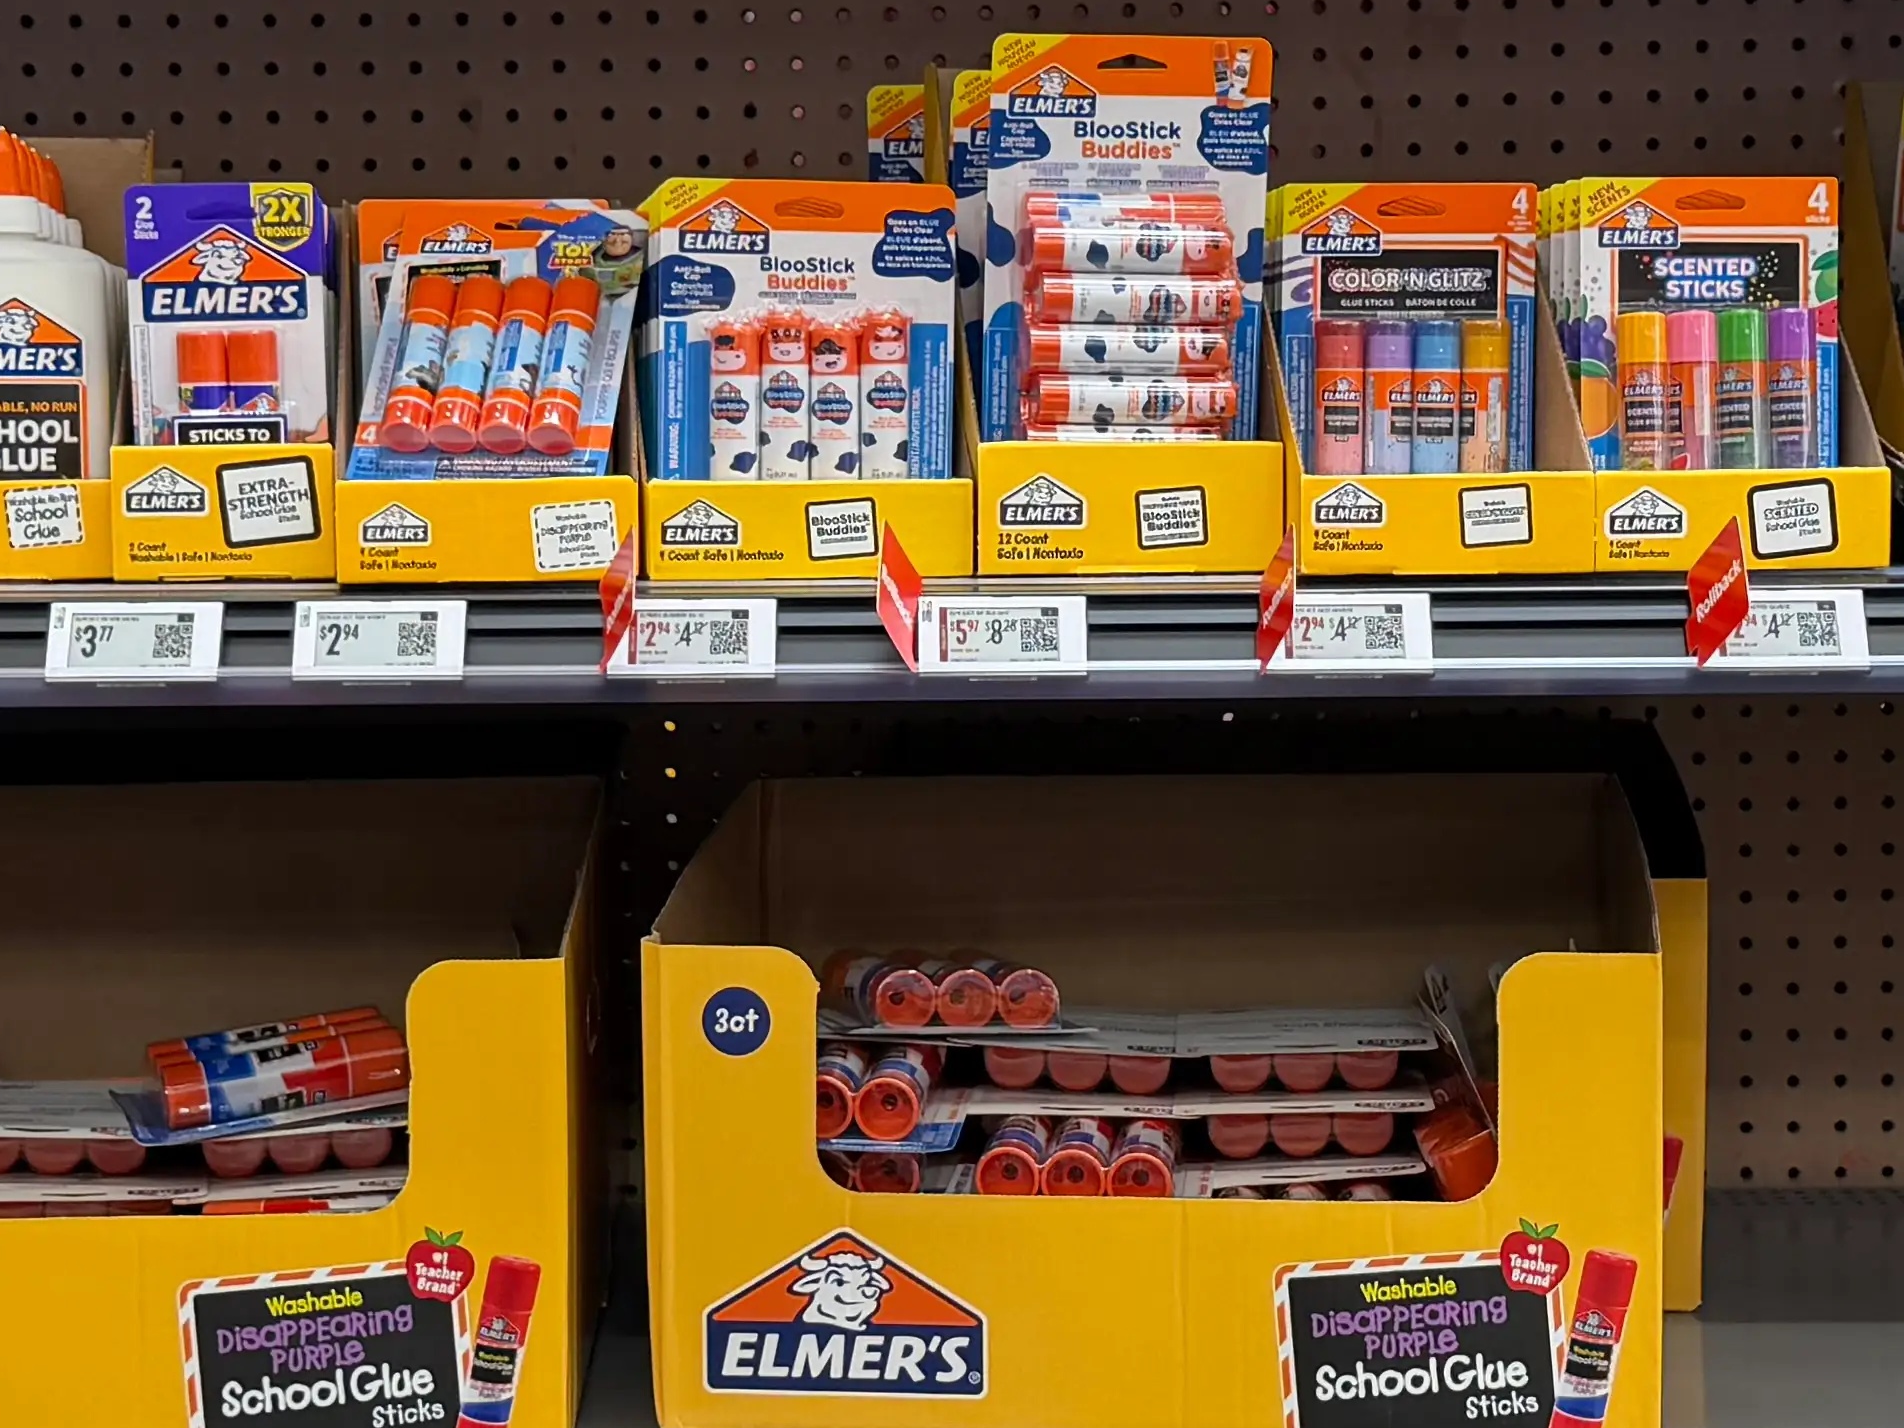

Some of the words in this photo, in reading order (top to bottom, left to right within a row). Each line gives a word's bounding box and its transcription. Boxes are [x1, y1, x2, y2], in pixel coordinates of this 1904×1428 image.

[1013, 97, 1092, 115] ELMER'S
[1073, 122, 1181, 140] BlooStick
[263, 195, 302, 224] 2X
[1511, 188, 1529, 214] 4
[1808, 184, 1829, 210] 4
[150, 286, 300, 314] ELMER'S
[1695, 555, 1743, 626] Rollback
[415, 1263, 463, 1282] Teacher
[1509, 1254, 1558, 1274] Teacher
[417, 1278, 456, 1296] Brand
[1360, 1275, 1457, 1303] Washable
[1512, 1271, 1550, 1287] Brand
[266, 1287, 363, 1317] Washable
[720, 1334, 971, 1382] ELMER'S
[1315, 1357, 1437, 1401] School
[1444, 1353, 1529, 1392] Glue
